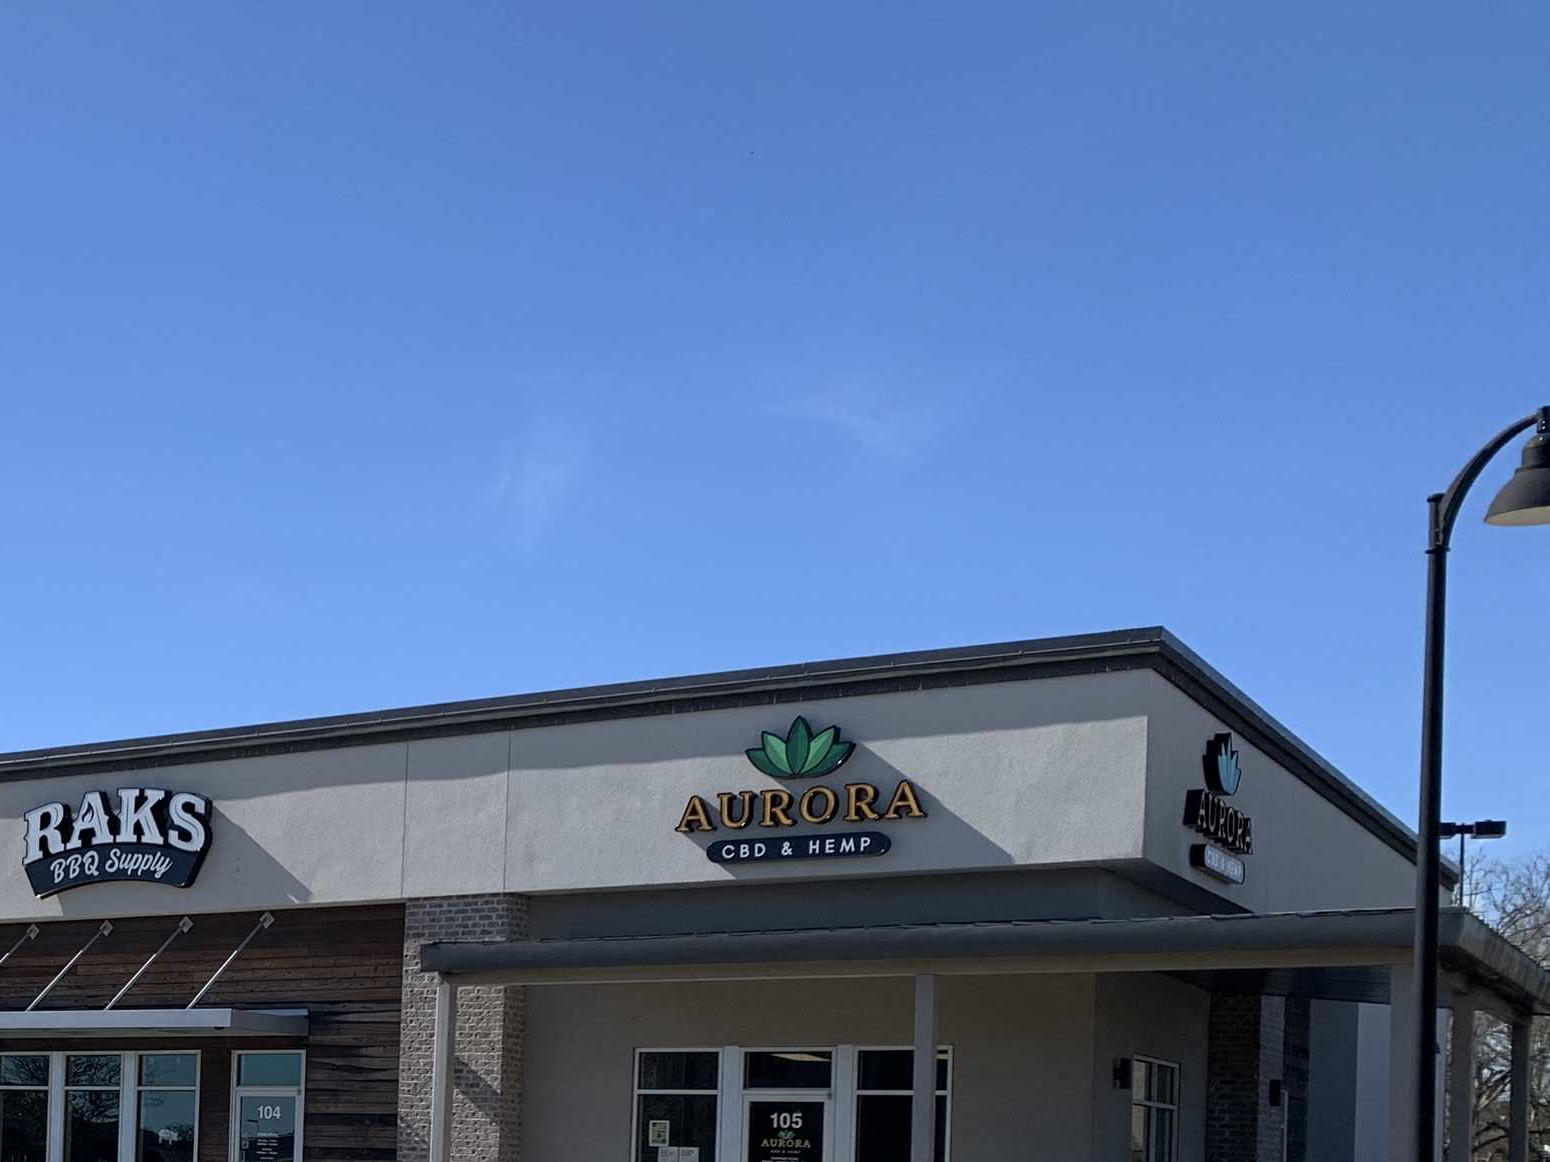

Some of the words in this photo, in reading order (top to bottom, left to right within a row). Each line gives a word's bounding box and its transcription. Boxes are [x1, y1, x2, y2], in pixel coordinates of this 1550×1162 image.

[675, 779, 927, 832] AURORA
[23, 787, 207, 865] RAKS
[1197, 790, 1253, 855] AURORA
[721, 842, 767, 859] CBD
[781, 841, 793, 856] &
[808, 836, 872, 855] HEMP
[50, 850, 100, 884] BBQ
[105, 848, 174, 879] Supply
[257, 1105, 282, 1119] 104
[770, 1112, 803, 1129] 105
[760, 1138, 811, 1149] AURORA
